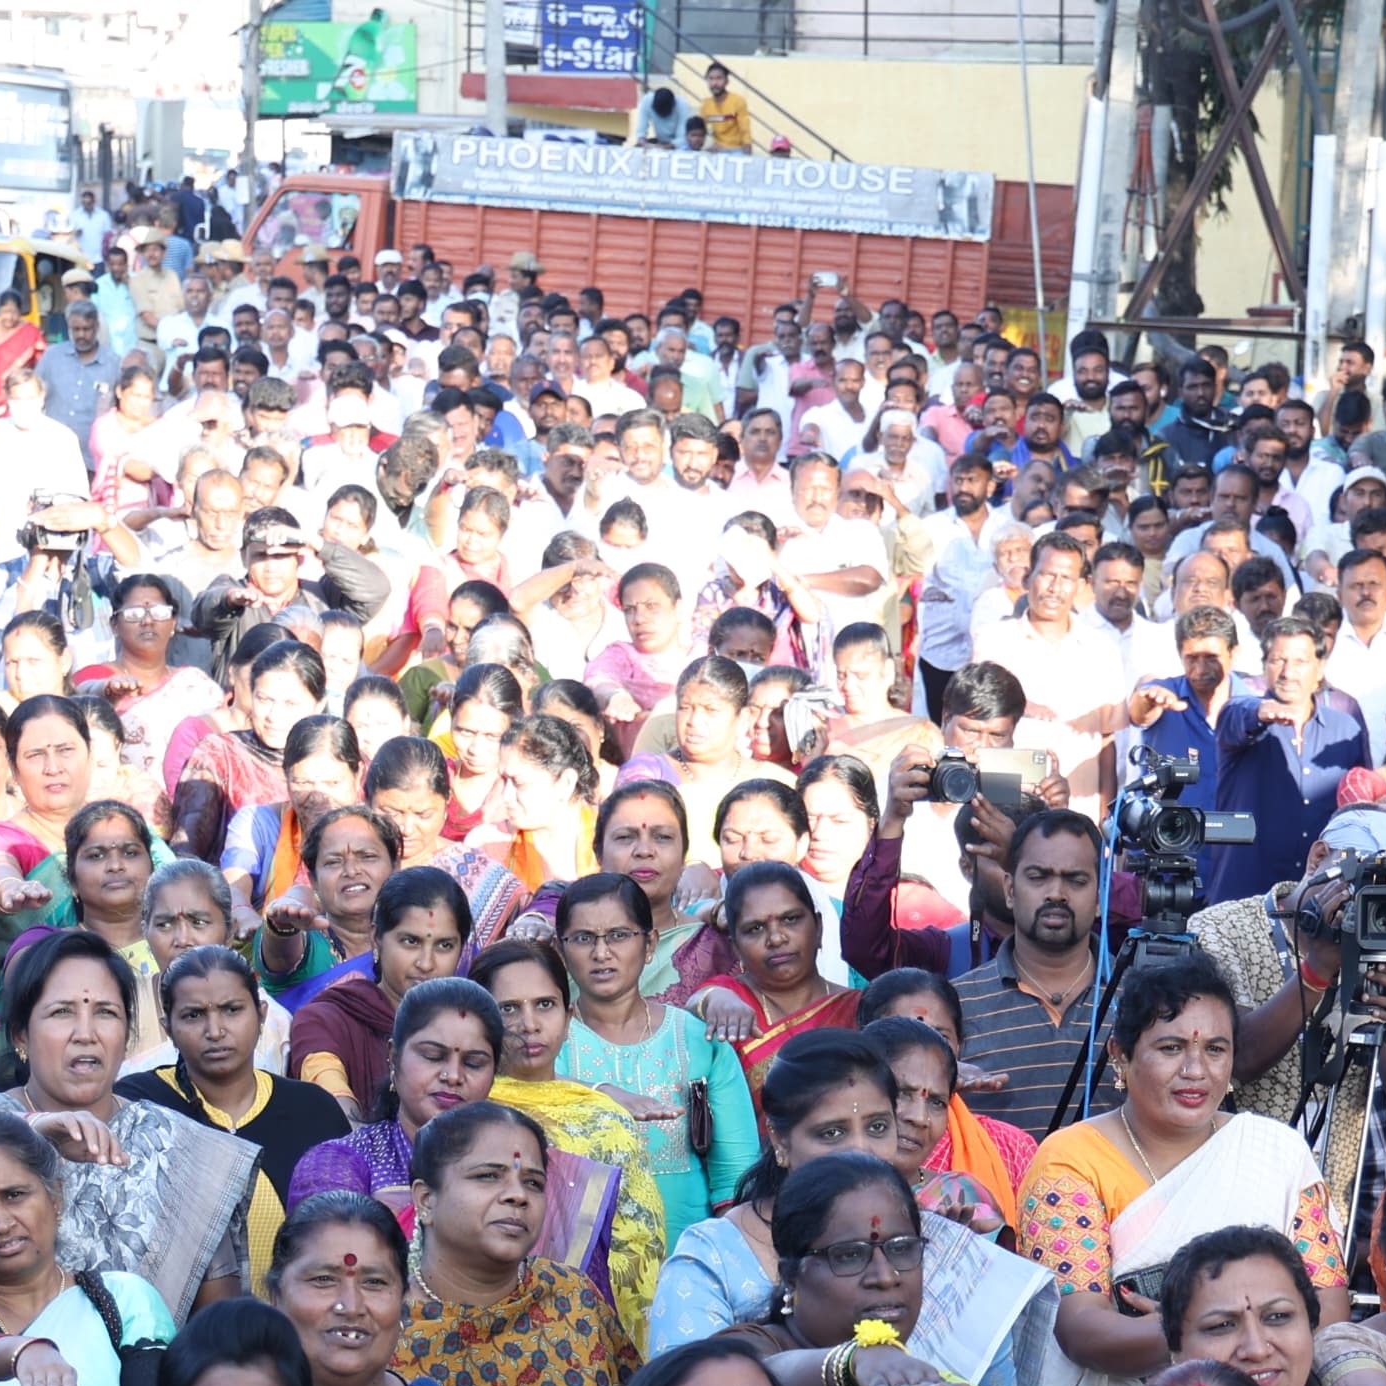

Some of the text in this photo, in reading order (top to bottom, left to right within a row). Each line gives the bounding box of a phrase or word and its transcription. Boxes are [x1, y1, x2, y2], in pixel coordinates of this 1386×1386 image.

[451, 139, 634, 177] PHOENIX
[647, 150, 753, 183] TENT
[762, 159, 915, 195] HOUSE
